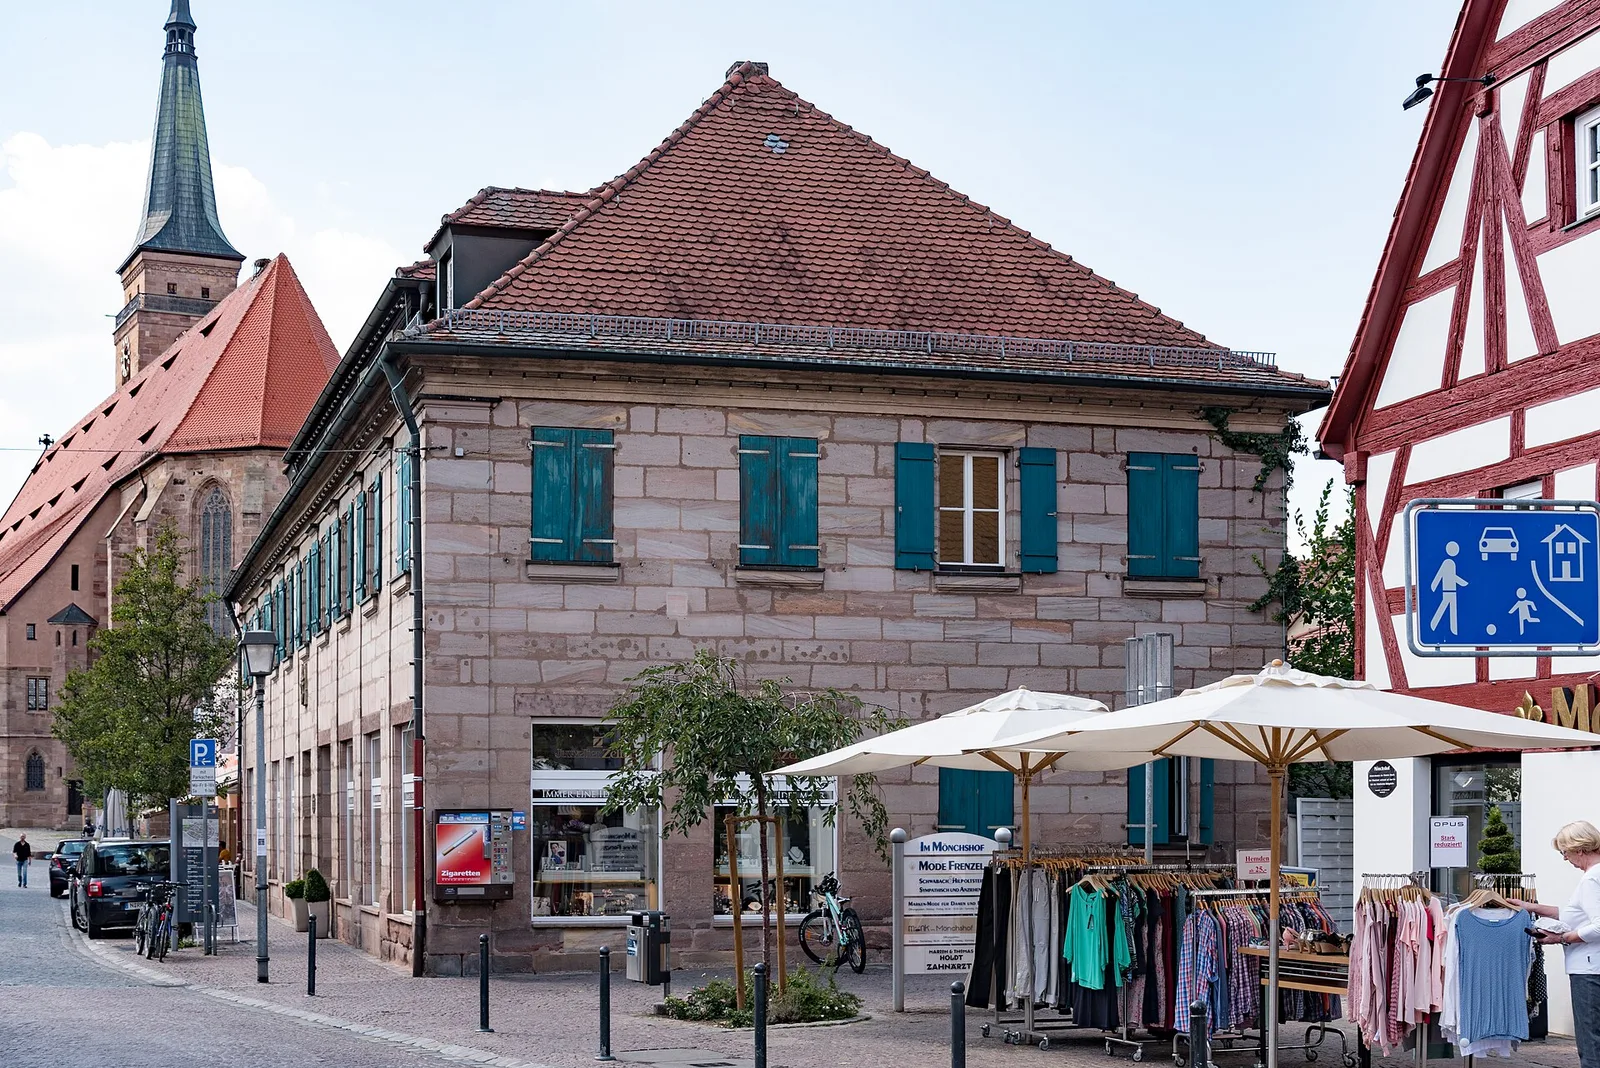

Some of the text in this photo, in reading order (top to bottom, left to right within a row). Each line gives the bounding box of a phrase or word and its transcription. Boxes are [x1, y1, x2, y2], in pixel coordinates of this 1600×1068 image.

[194, 743, 208, 765] P
[542, 790, 573, 798] IMMER
[576, 790, 597, 798] EINE
[919, 861, 984, 871] MODE FRENZEL
